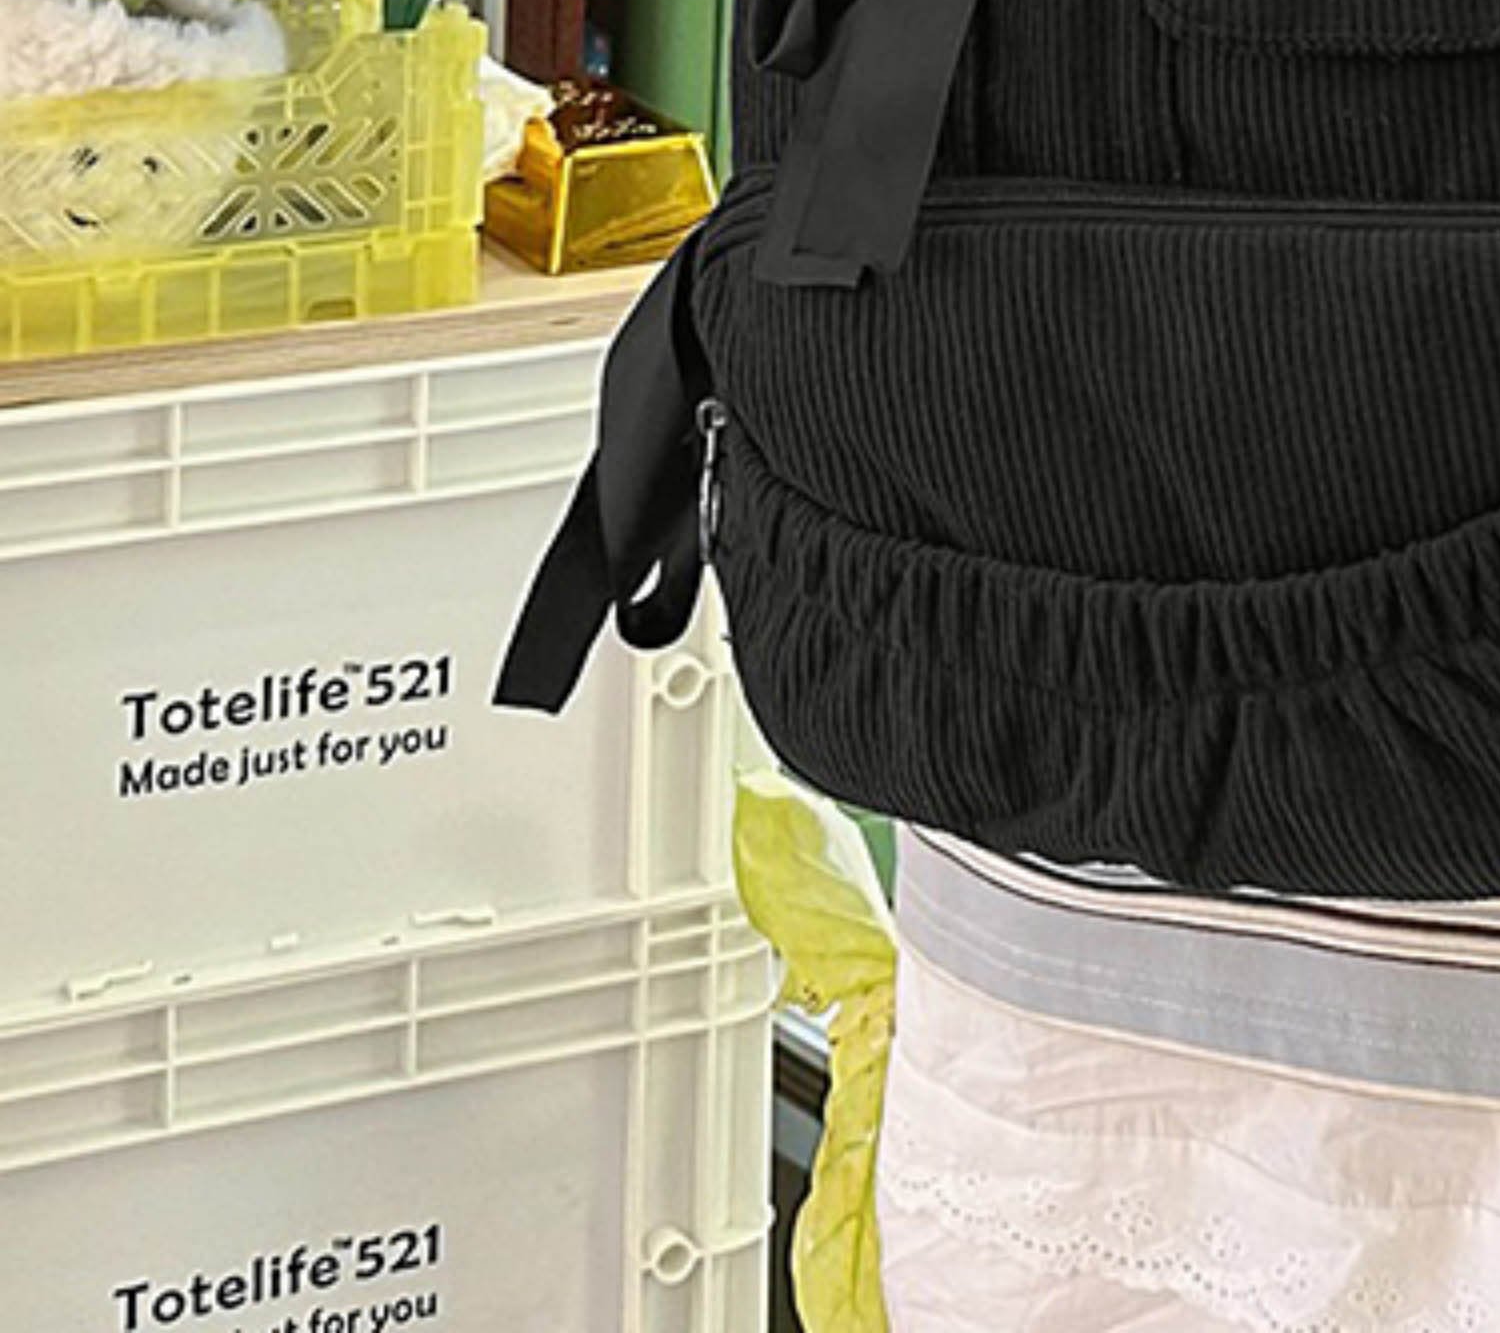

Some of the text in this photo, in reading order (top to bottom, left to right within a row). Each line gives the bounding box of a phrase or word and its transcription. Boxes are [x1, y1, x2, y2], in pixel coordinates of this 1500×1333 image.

[119, 724, 449, 798] Made just for you
[369, 1292, 438, 1333] you
